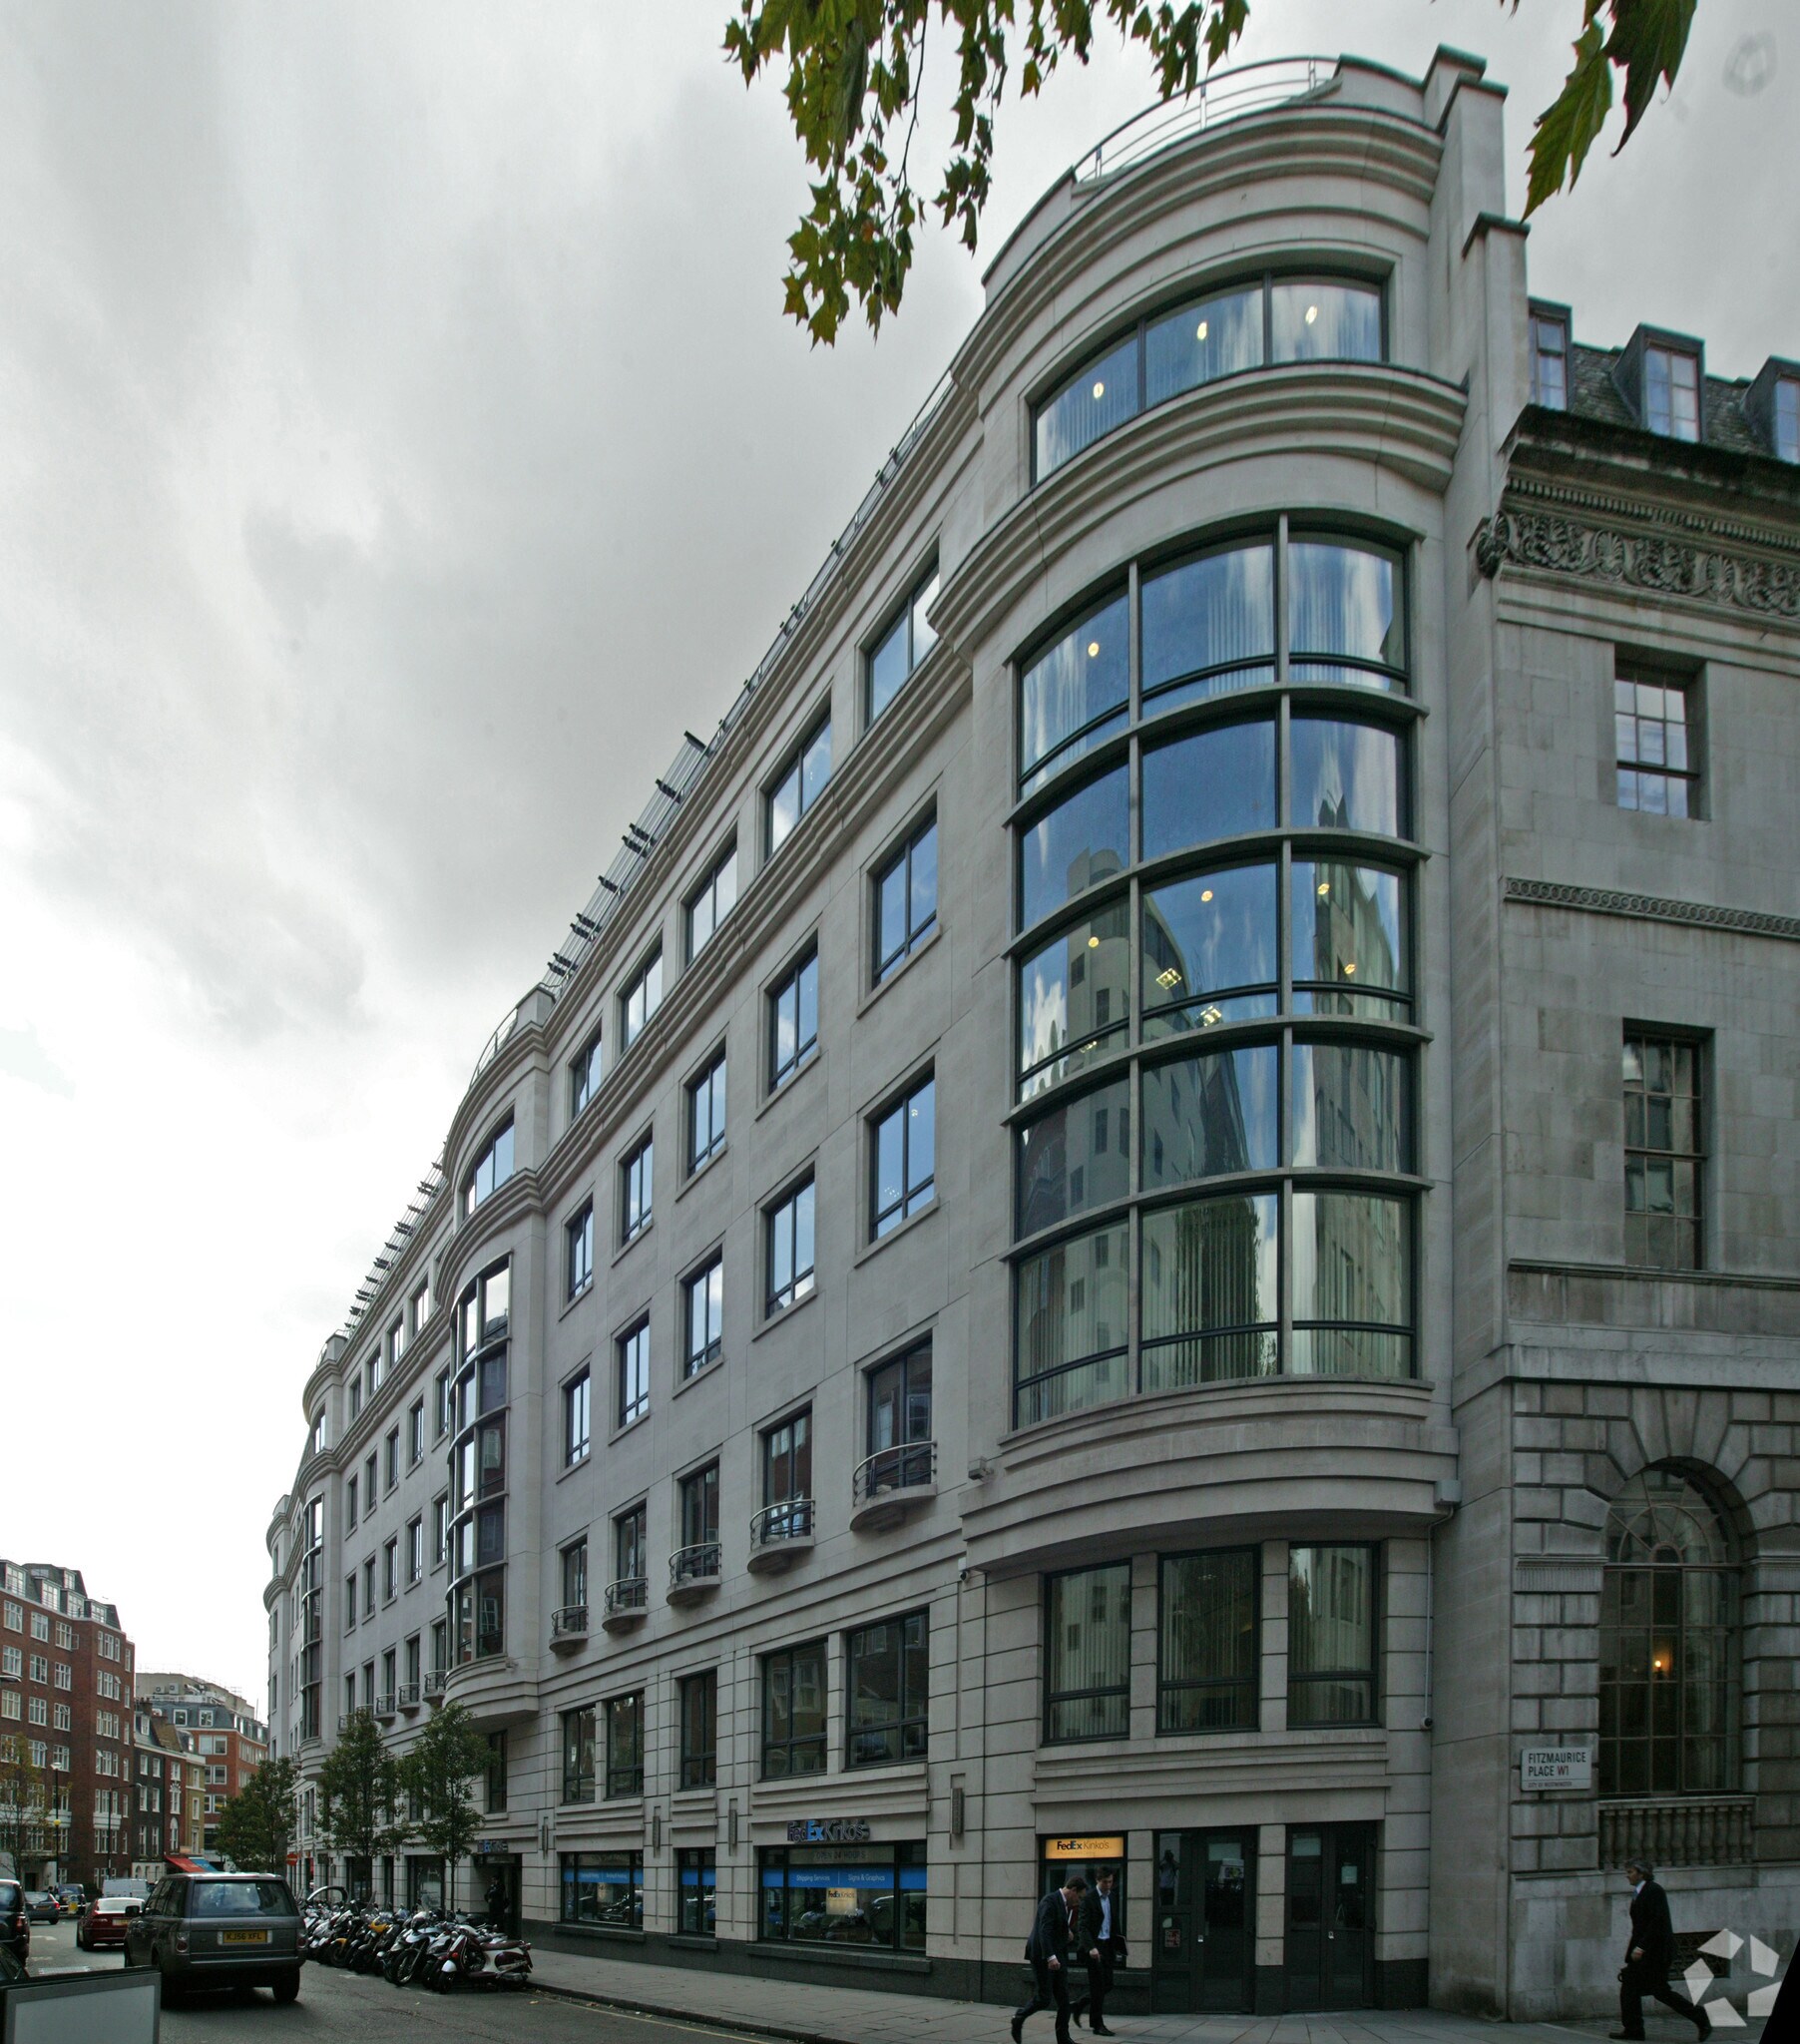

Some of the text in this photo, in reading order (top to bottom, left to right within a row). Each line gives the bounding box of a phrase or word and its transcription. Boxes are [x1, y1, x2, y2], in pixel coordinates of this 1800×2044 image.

[1528, 1752, 1586, 1764] FITZMAURICE
[1528, 1766, 1570, 1777] PLACE W1
[787, 1819, 824, 1842] FedEx
[1057, 1838, 1110, 1850] FedEx Kinko's
[796, 1873, 813, 1882] Shipping
[864, 1873, 886, 1882] Graphics
